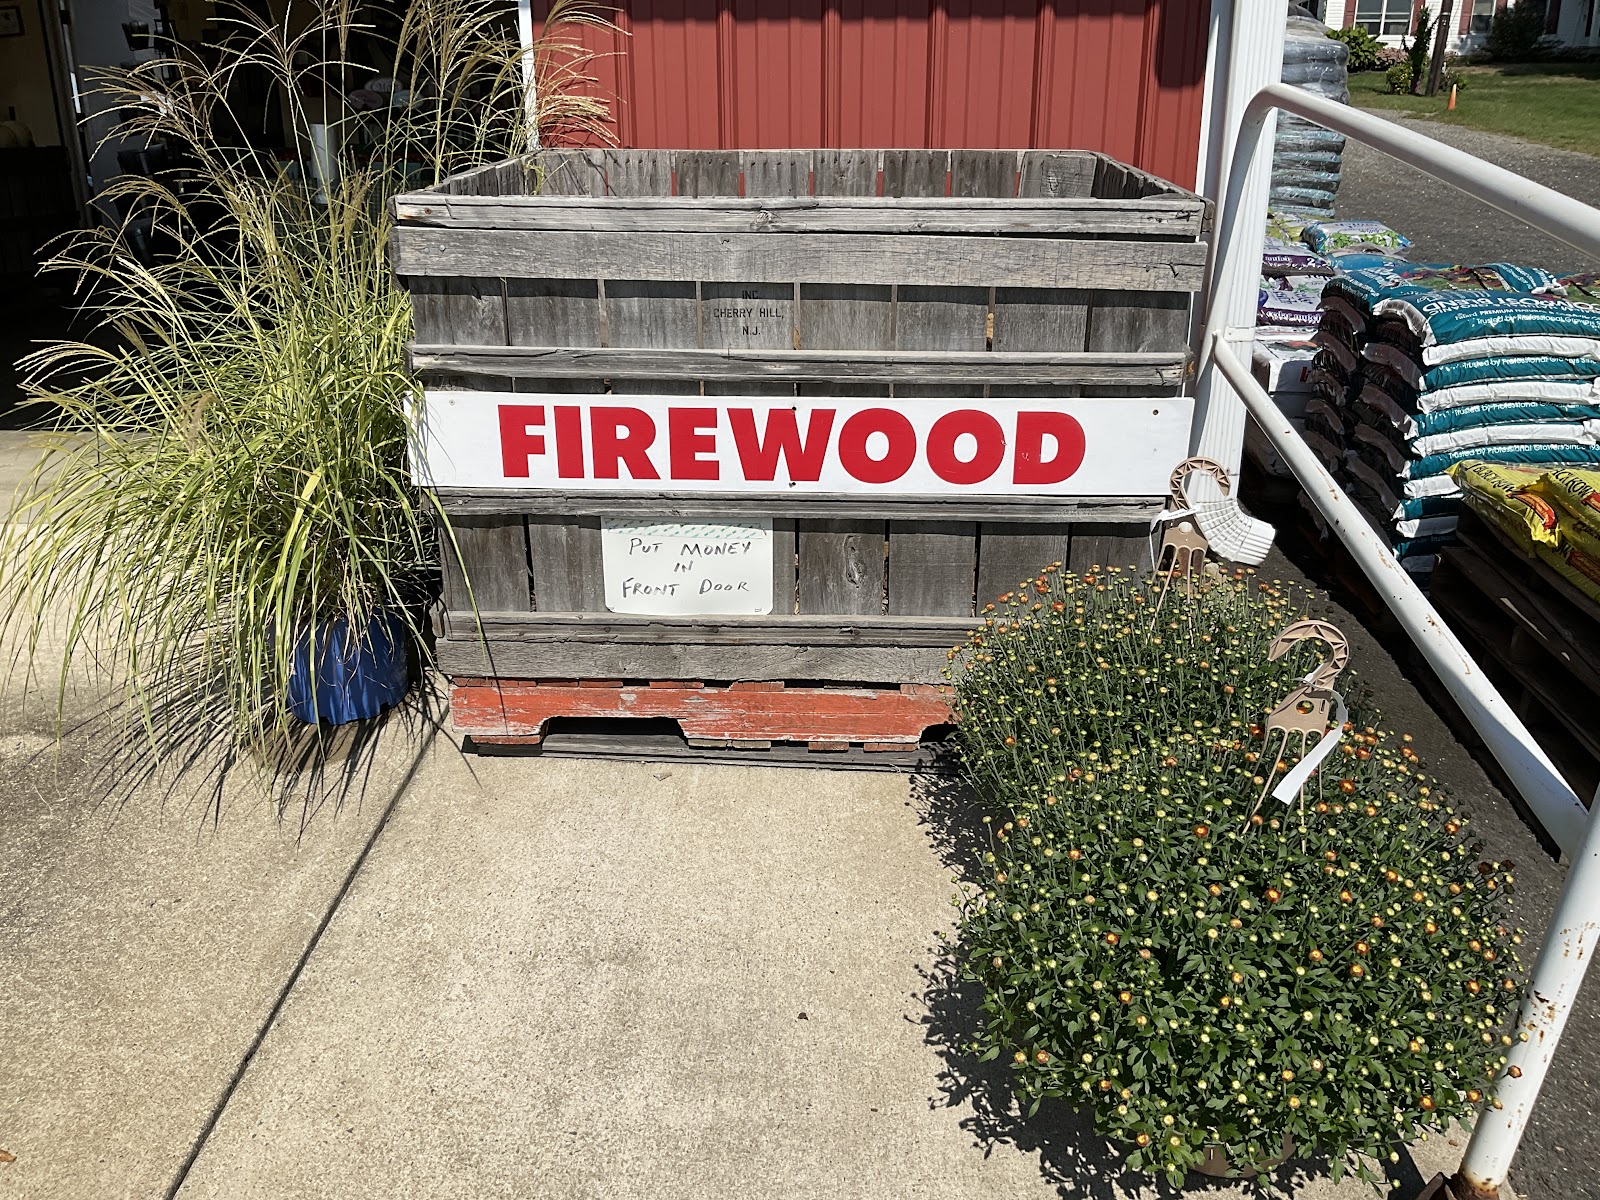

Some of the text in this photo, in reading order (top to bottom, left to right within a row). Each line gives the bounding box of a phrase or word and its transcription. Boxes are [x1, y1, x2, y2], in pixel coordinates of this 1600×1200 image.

[713, 308, 784, 319] CHERRY HILL,
[498, 404, 1087, 485] FIREWOOD
[629, 537, 752, 557] PUT MONEY
[673, 560, 694, 573] IN
[622, 577, 750, 598] FRONT DOOR
